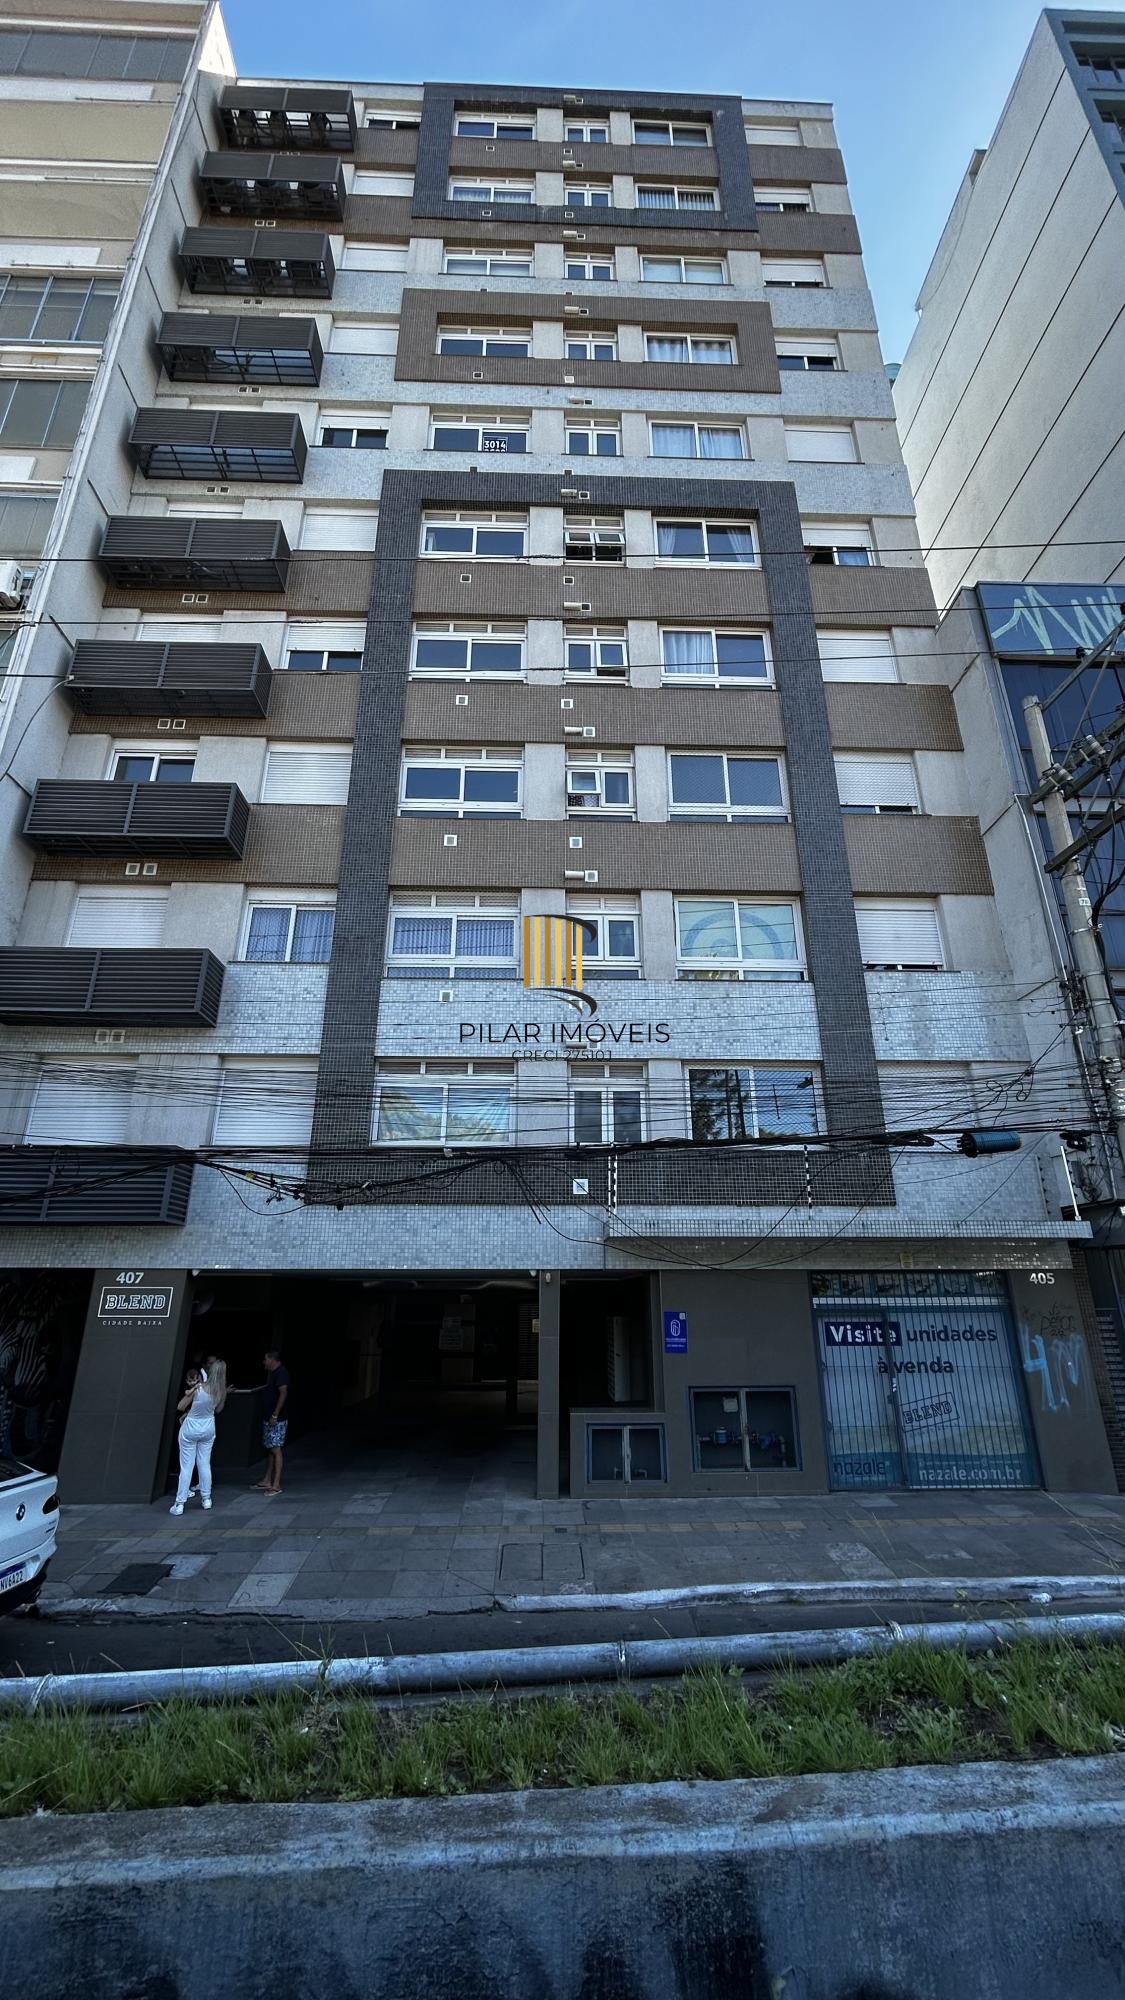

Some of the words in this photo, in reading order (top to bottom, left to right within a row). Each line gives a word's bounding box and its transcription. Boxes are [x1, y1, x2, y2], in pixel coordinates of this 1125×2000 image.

[484, 441, 506, 449] 3014
[116, 1271, 144, 1284] 407
[1029, 1272, 1056, 1285] 405
[105, 1294, 166, 1310] BLEND
[830, 1324, 897, 1343] Visite
[907, 1324, 998, 1342] unidades
[893, 1356, 954, 1374] venda
[903, 1401, 953, 1424] BLEND
[834, 1458, 887, 1476] nazale
[919, 1465, 1022, 1481] nazale.com.br
